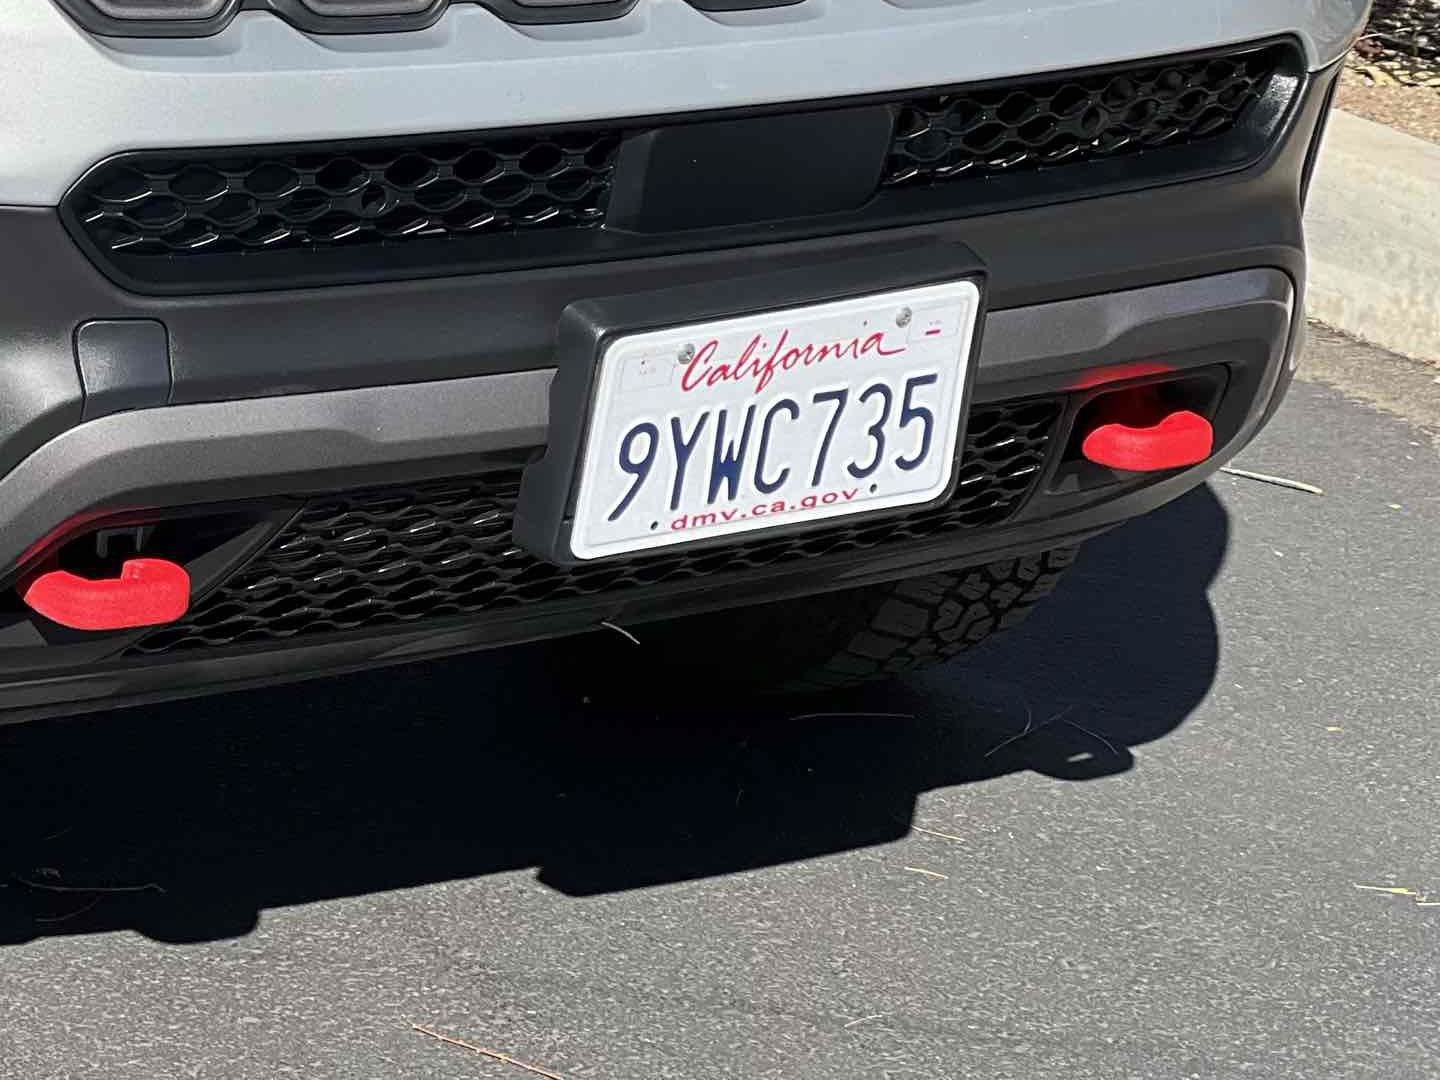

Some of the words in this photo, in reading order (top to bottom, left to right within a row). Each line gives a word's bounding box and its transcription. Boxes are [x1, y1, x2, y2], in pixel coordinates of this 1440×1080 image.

[681, 328, 906, 394] California
[607, 373, 939, 522] 9YWC735
[670, 487, 860, 532] dmv.ca.gov
